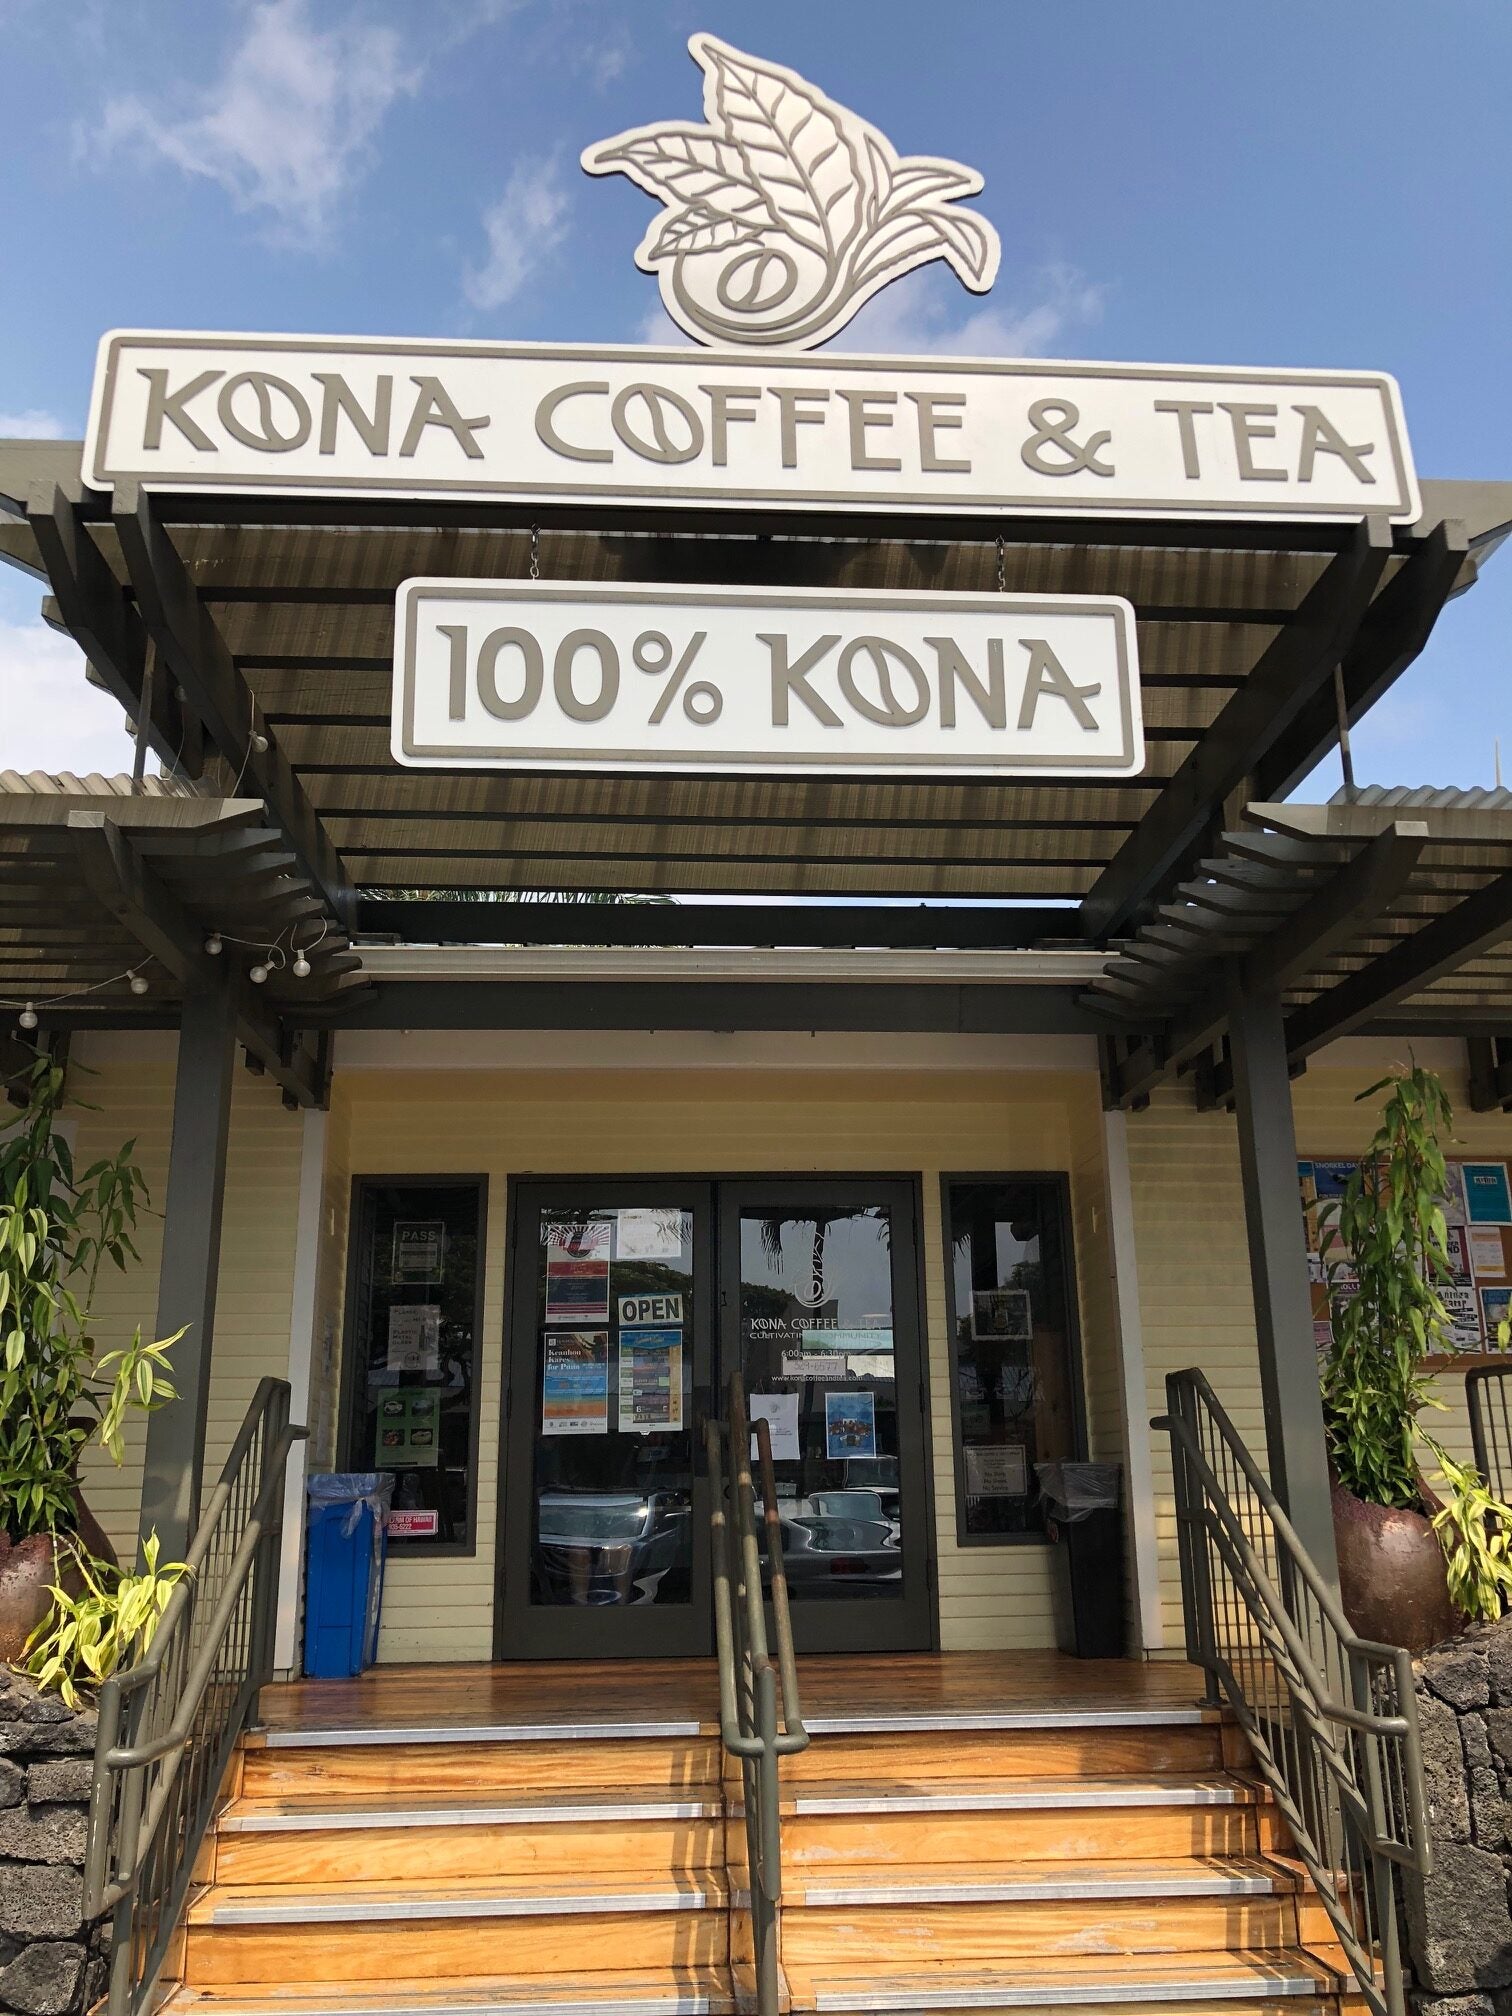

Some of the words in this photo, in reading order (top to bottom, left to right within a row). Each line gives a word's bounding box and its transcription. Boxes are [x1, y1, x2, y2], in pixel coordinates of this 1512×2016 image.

[136, 368, 491, 459] KONA
[535, 381, 971, 474] COFFEE
[1020, 397, 1115, 478] &
[1153, 399, 1376, 485] TEA
[436, 625, 723, 726] 100%
[755, 633, 1102, 731] KONA
[402, 1231, 436, 1241] PASS
[622, 1298, 679, 1322] OPEN
[750, 1318, 787, 1330] KONA
[791, 1318, 838, 1330] COFFEE
